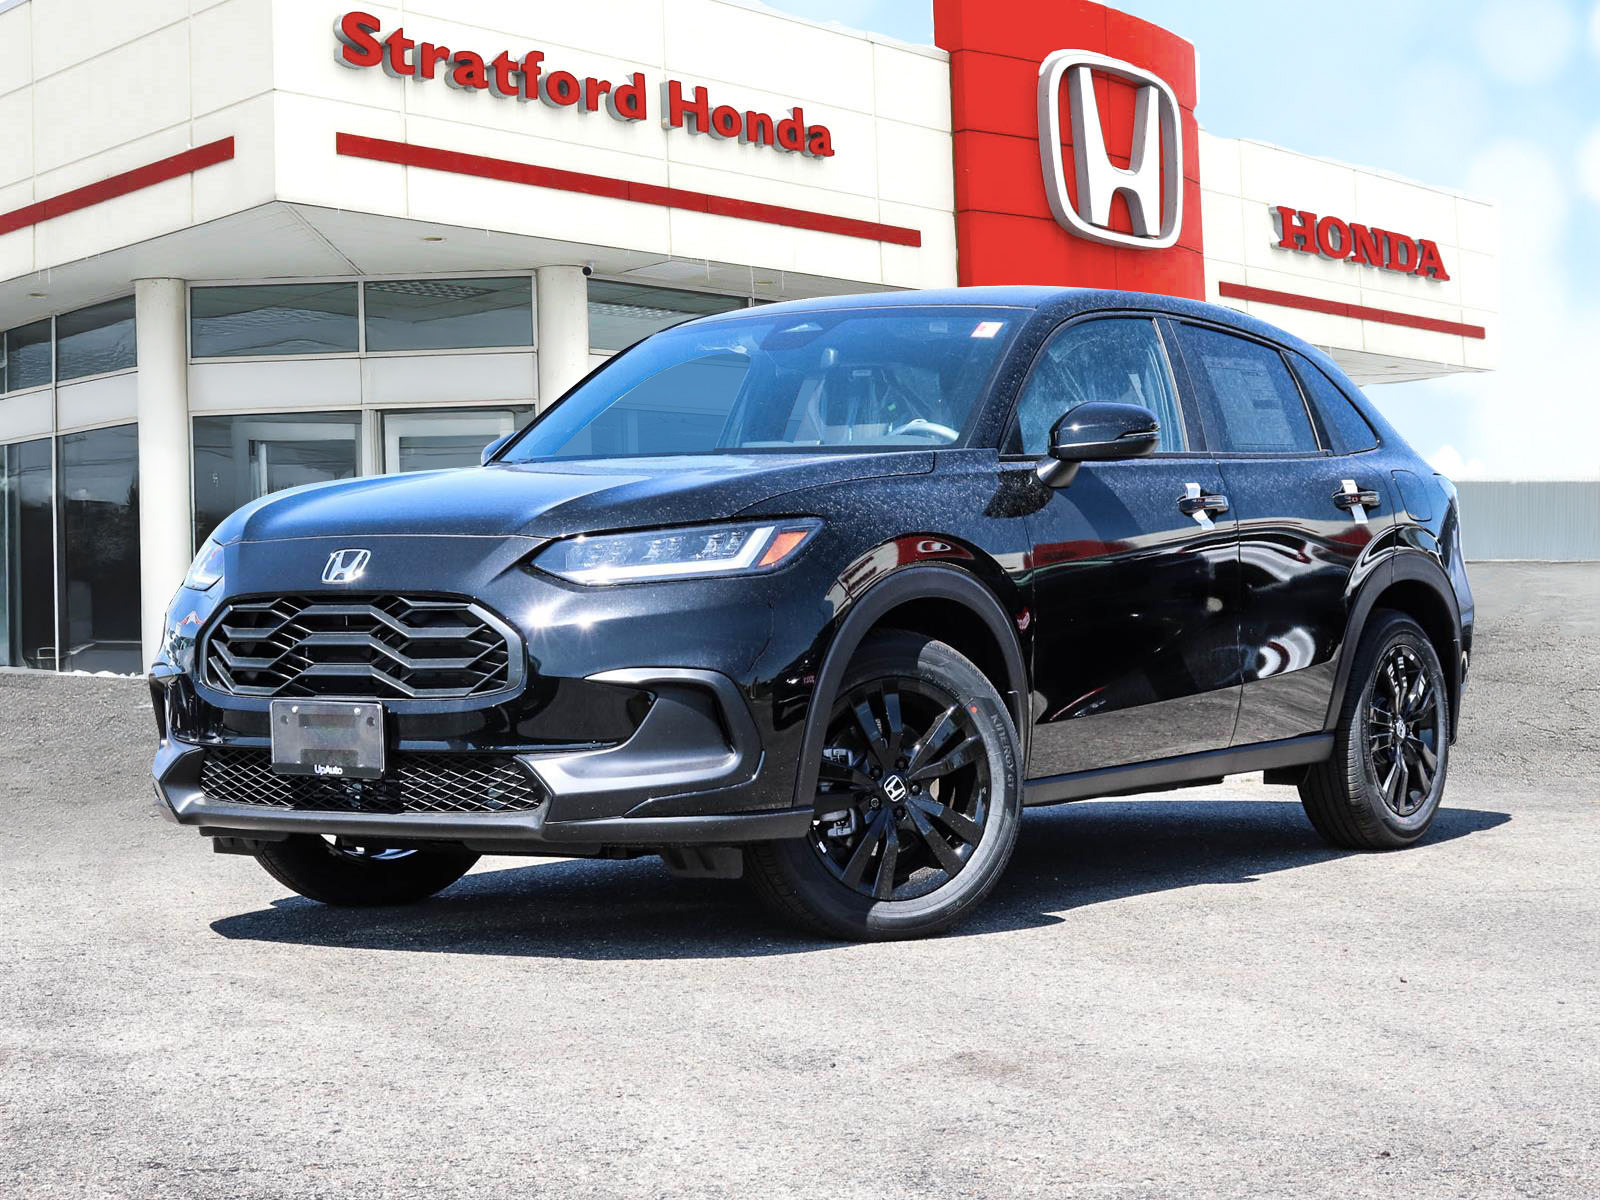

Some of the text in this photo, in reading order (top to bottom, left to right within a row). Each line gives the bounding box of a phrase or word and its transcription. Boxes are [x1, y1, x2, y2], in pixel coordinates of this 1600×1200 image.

[337, 11, 834, 157] Stratford Honda
[1271, 205, 1450, 282] HONDA
